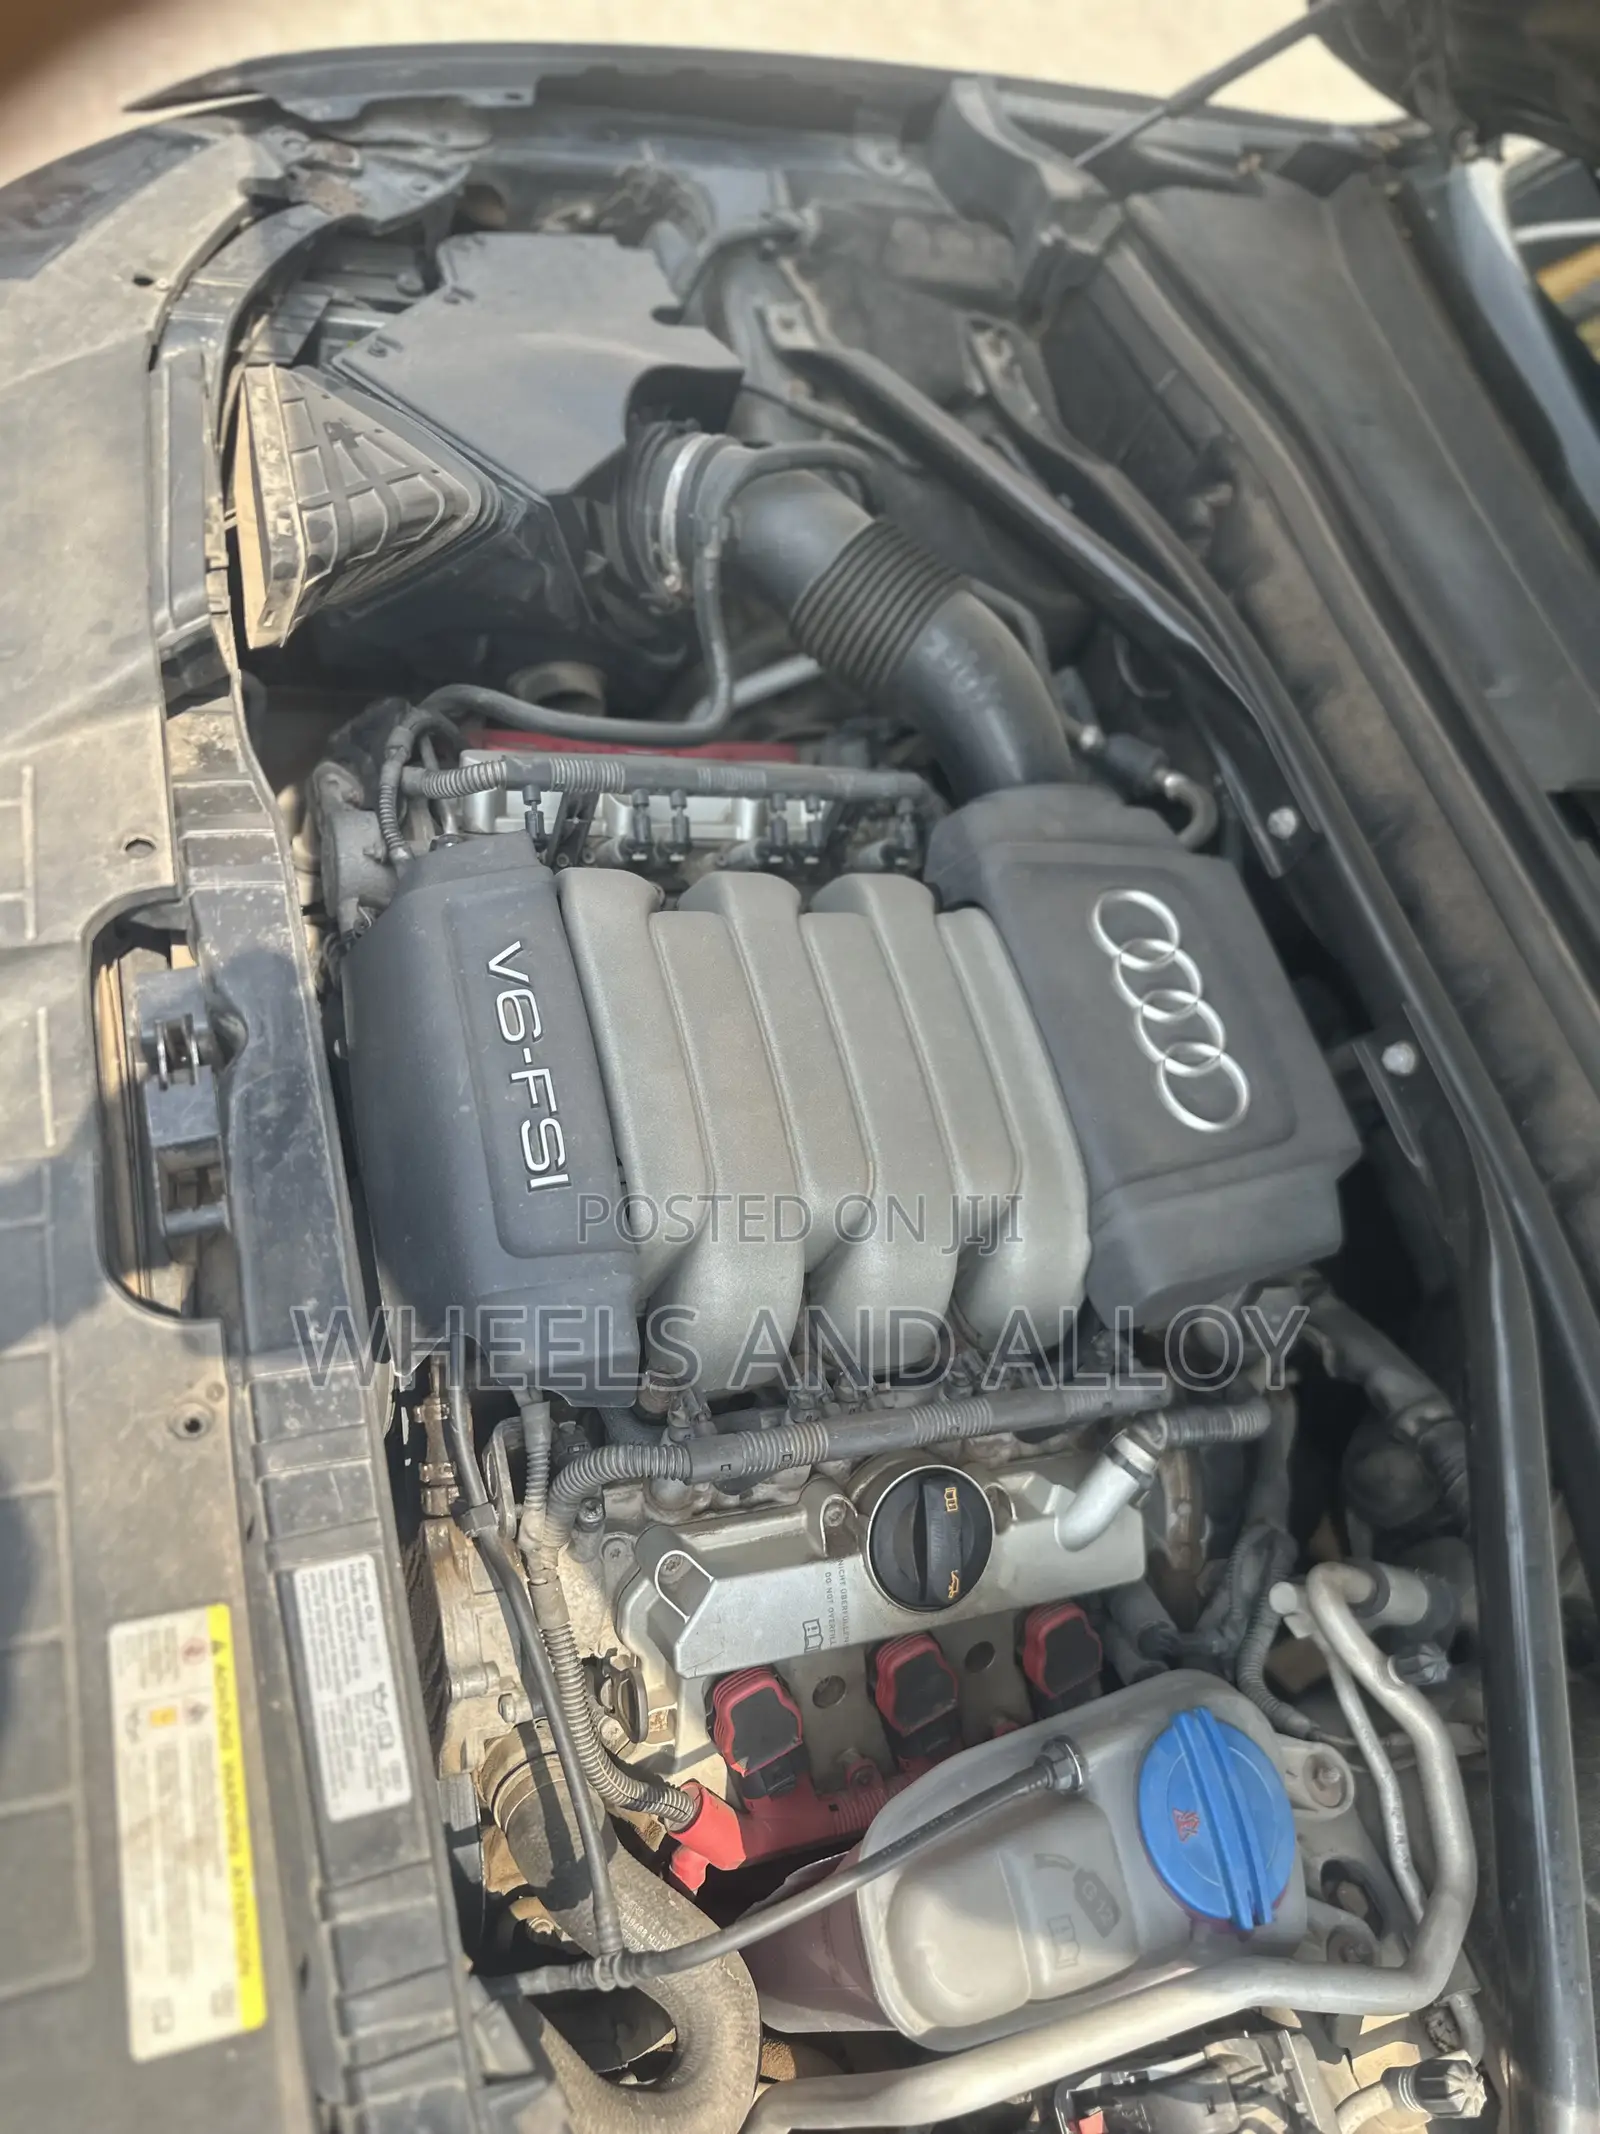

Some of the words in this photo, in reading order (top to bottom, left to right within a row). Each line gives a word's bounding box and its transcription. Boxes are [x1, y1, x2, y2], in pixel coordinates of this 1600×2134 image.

[487, 940, 571, 1191] V6-FSI
[825, 1571, 833, 1584] DO
[826, 1587, 835, 1604] NOT
[828, 1606, 838, 1646] OVERFILL
